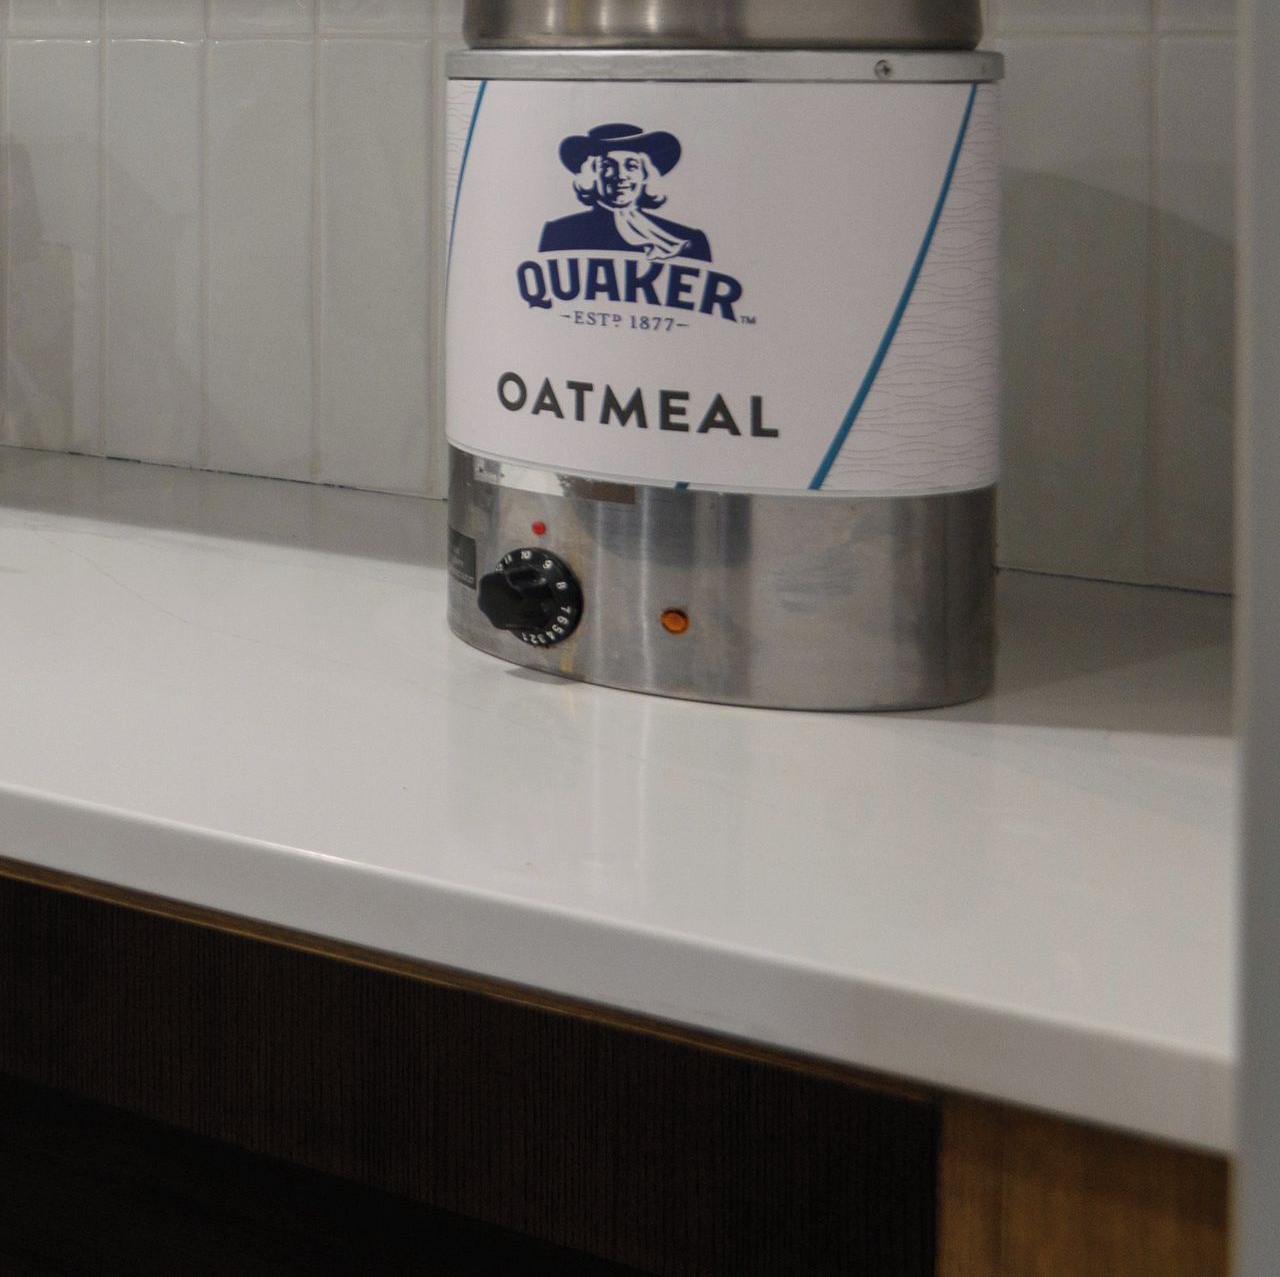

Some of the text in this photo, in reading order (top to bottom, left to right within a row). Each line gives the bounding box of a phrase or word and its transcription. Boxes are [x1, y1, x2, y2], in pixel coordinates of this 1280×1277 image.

[517, 257, 743, 322] QUAKER
[497, 371, 779, 438] OATMEAL
[542, 559, 553, 569] 9
[555, 581, 567, 590] 8
[560, 606, 571, 614] 7
[557, 615, 569, 625] 6
[552, 624, 564, 634] 5
[529, 633, 538, 644] 2
[537, 634, 546, 643] 3
[546, 630, 555, 640] 4
